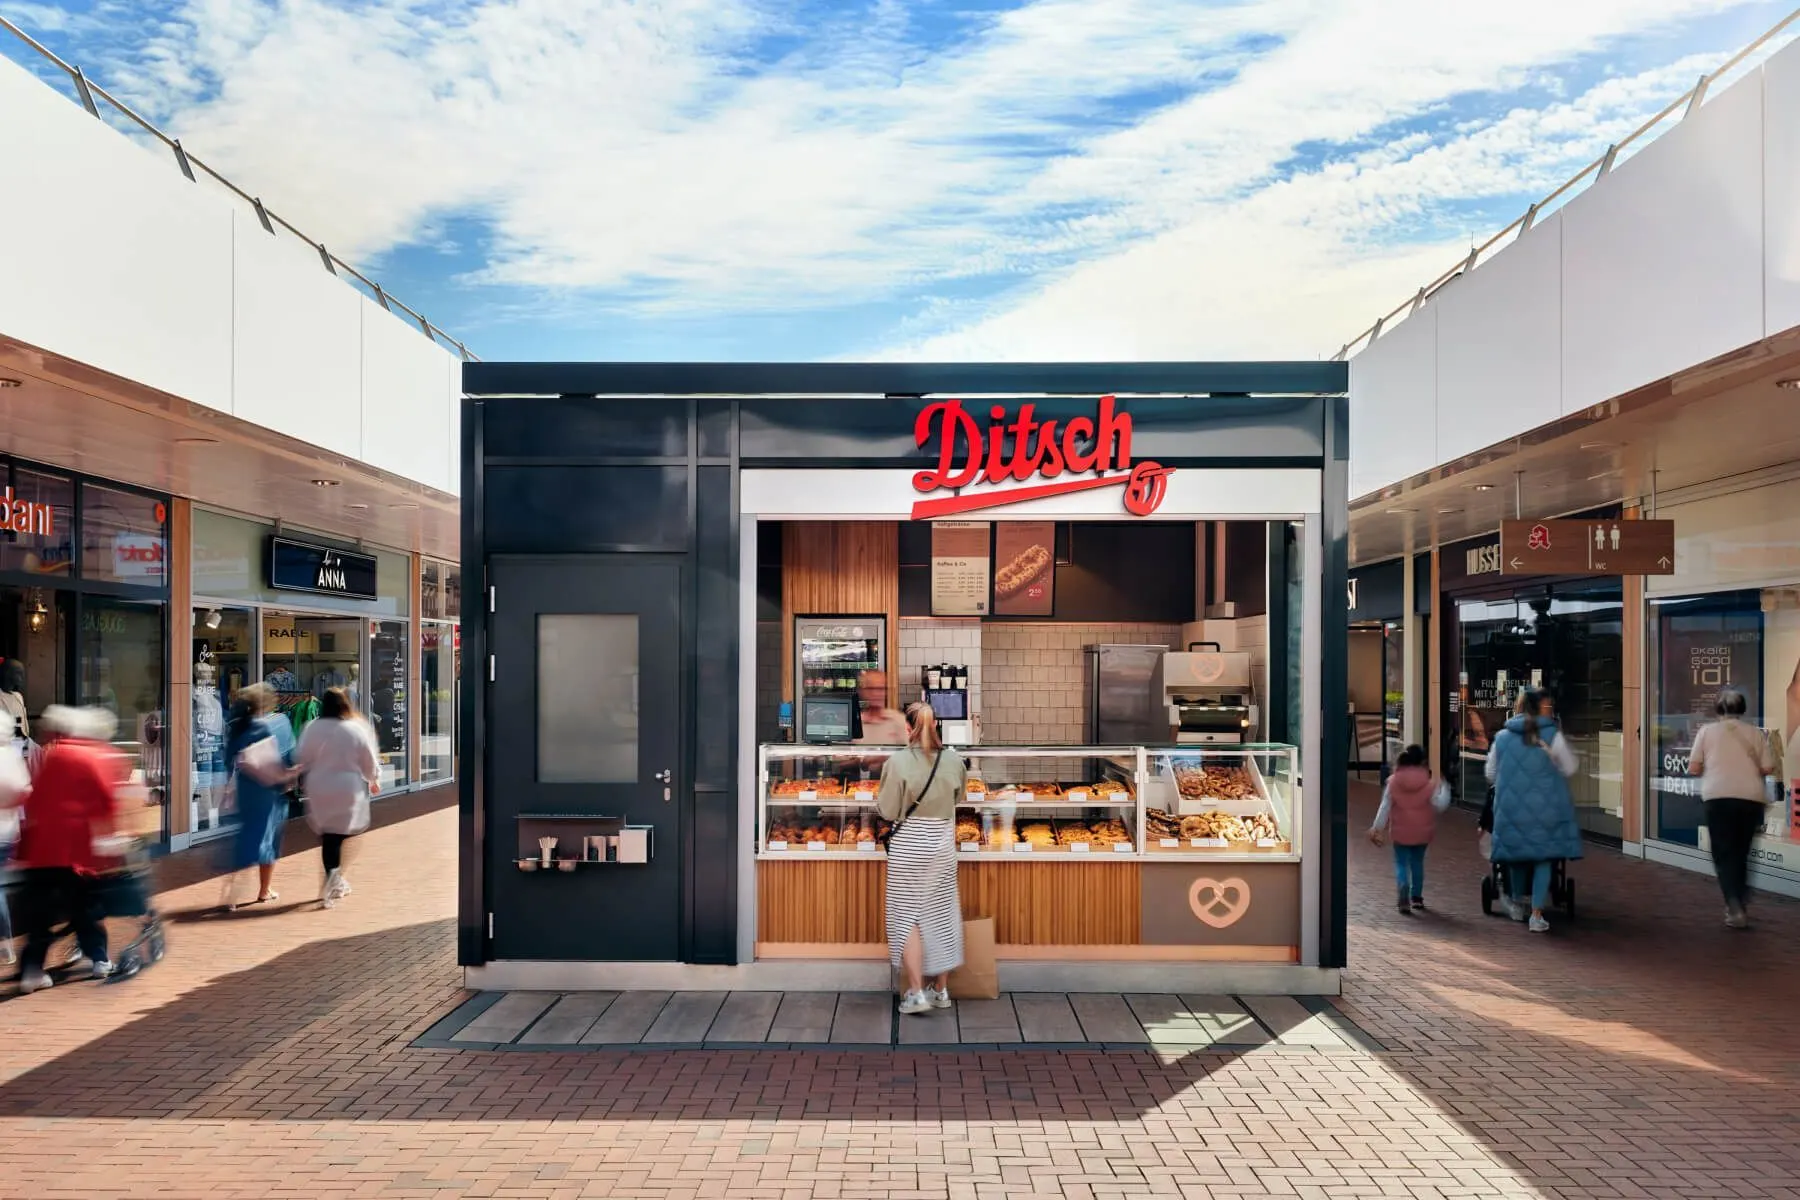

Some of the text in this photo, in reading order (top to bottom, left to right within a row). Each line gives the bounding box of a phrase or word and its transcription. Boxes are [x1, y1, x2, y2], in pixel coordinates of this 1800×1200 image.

[912, 395, 1133, 492] Ditsch
[1595, 562, 1607, 570] WC
[318, 567, 346, 590] ANNA
